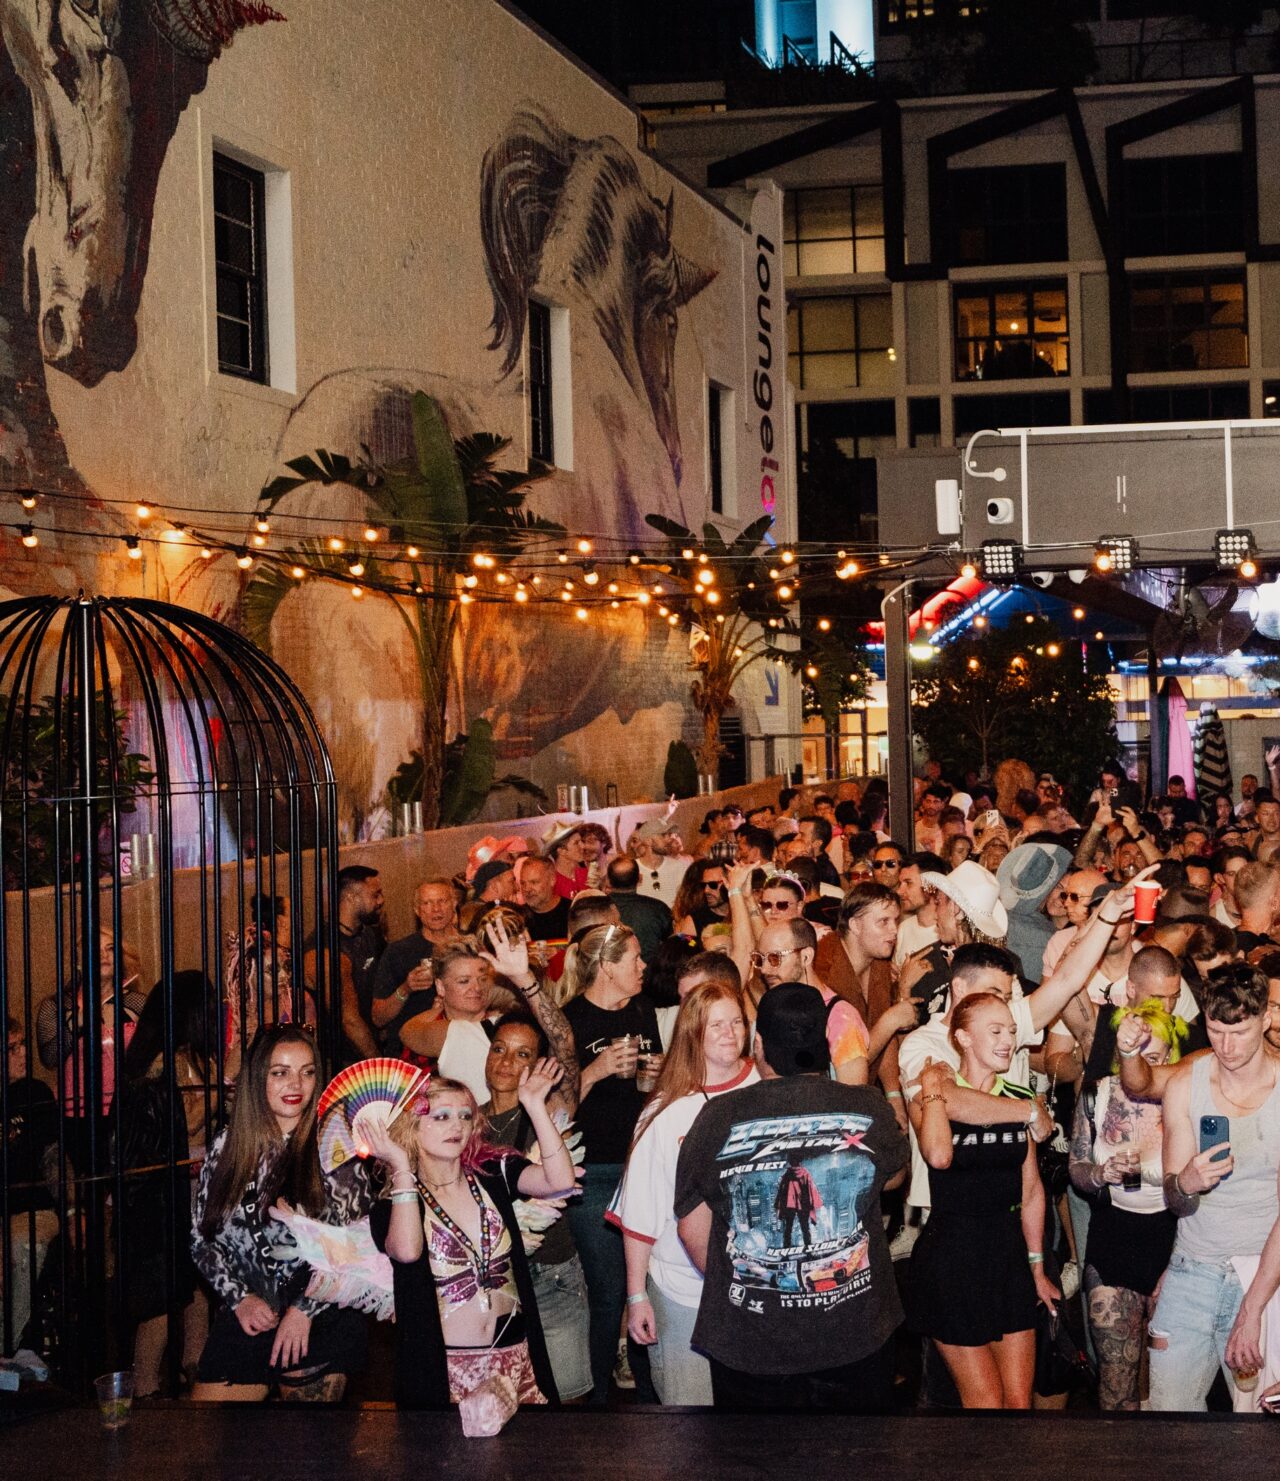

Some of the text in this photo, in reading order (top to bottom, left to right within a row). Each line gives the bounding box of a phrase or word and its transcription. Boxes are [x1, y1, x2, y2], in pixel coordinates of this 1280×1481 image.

[720, 1160, 788, 1180] NEVER REST
[767, 1246, 805, 1257] NEVER
[796, 1299, 811, 1308] TO
